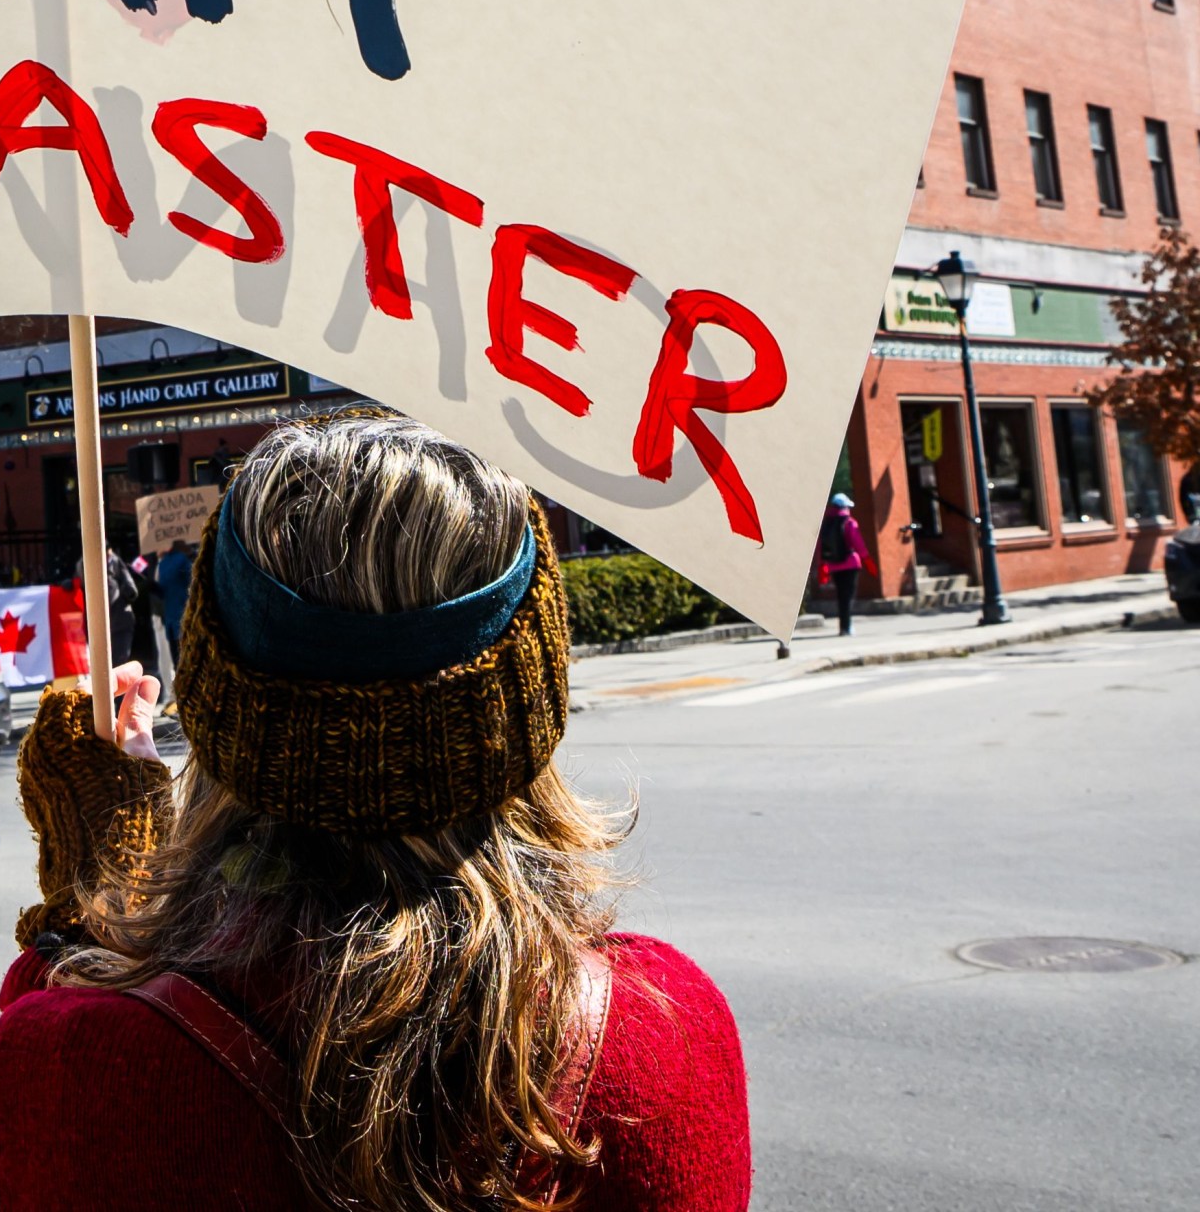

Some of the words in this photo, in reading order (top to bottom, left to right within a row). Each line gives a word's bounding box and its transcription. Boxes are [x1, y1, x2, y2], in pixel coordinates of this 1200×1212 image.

[55, 392, 116, 415] ARNS
[120, 387, 160, 408] HAND
[164, 380, 209, 400] CRAFT
[214, 371, 279, 396] GALLERY
[148, 492, 204, 513] CANADA
[160, 509, 183, 523] NOT
[186, 505, 209, 519] OUR
[154, 523, 192, 543] ENEMY
